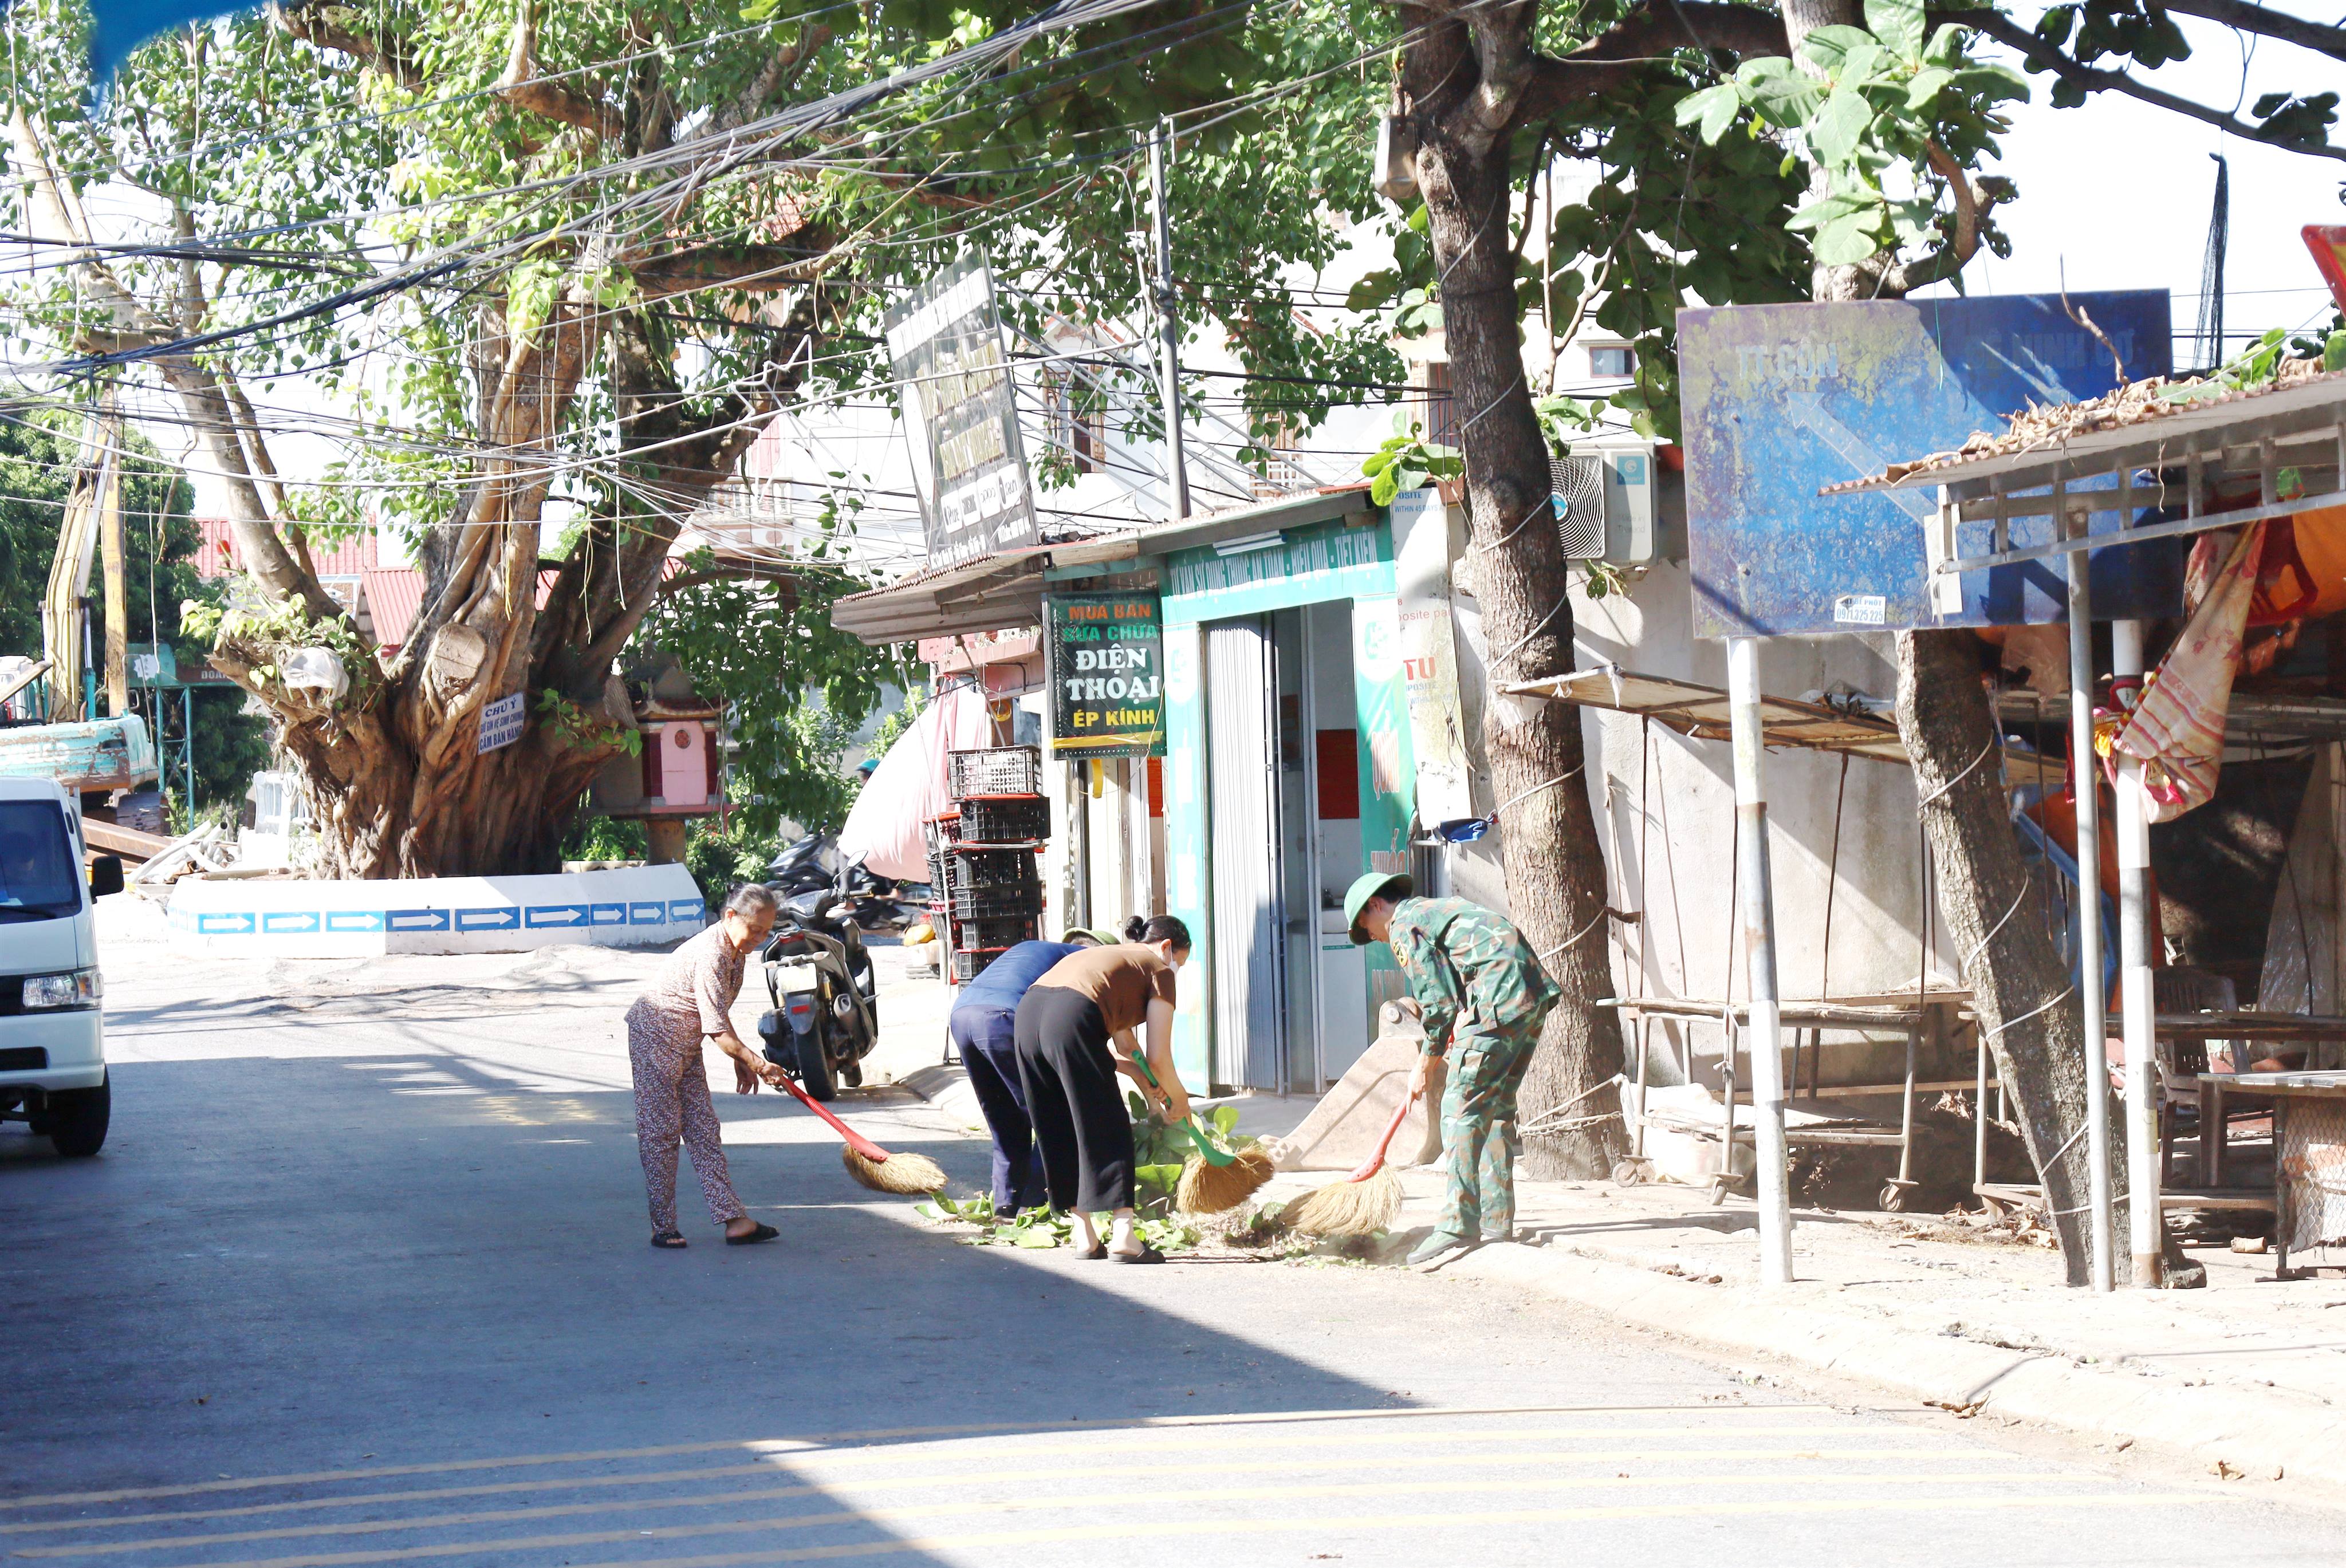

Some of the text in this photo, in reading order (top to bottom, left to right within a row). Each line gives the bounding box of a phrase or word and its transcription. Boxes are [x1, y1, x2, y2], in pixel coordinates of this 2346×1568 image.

[1736, 345, 1768, 380] TT
[1396, 491, 1422, 499] OSITE
[1394, 505, 1414, 513] WITHIN
[1068, 601, 1151, 620] MUA BÁN
[1062, 621, 1158, 643] SỬA CHỮA
[1076, 643, 1147, 674] ĐIỆN
[1065, 675, 1160, 704] THOẠI
[485, 697, 517, 718] CHÚ Ý
[1073, 707, 1155, 727] ÉP KÍNH
[493, 730, 506, 745] BÁN
[506, 724, 522, 740] HÀNG
